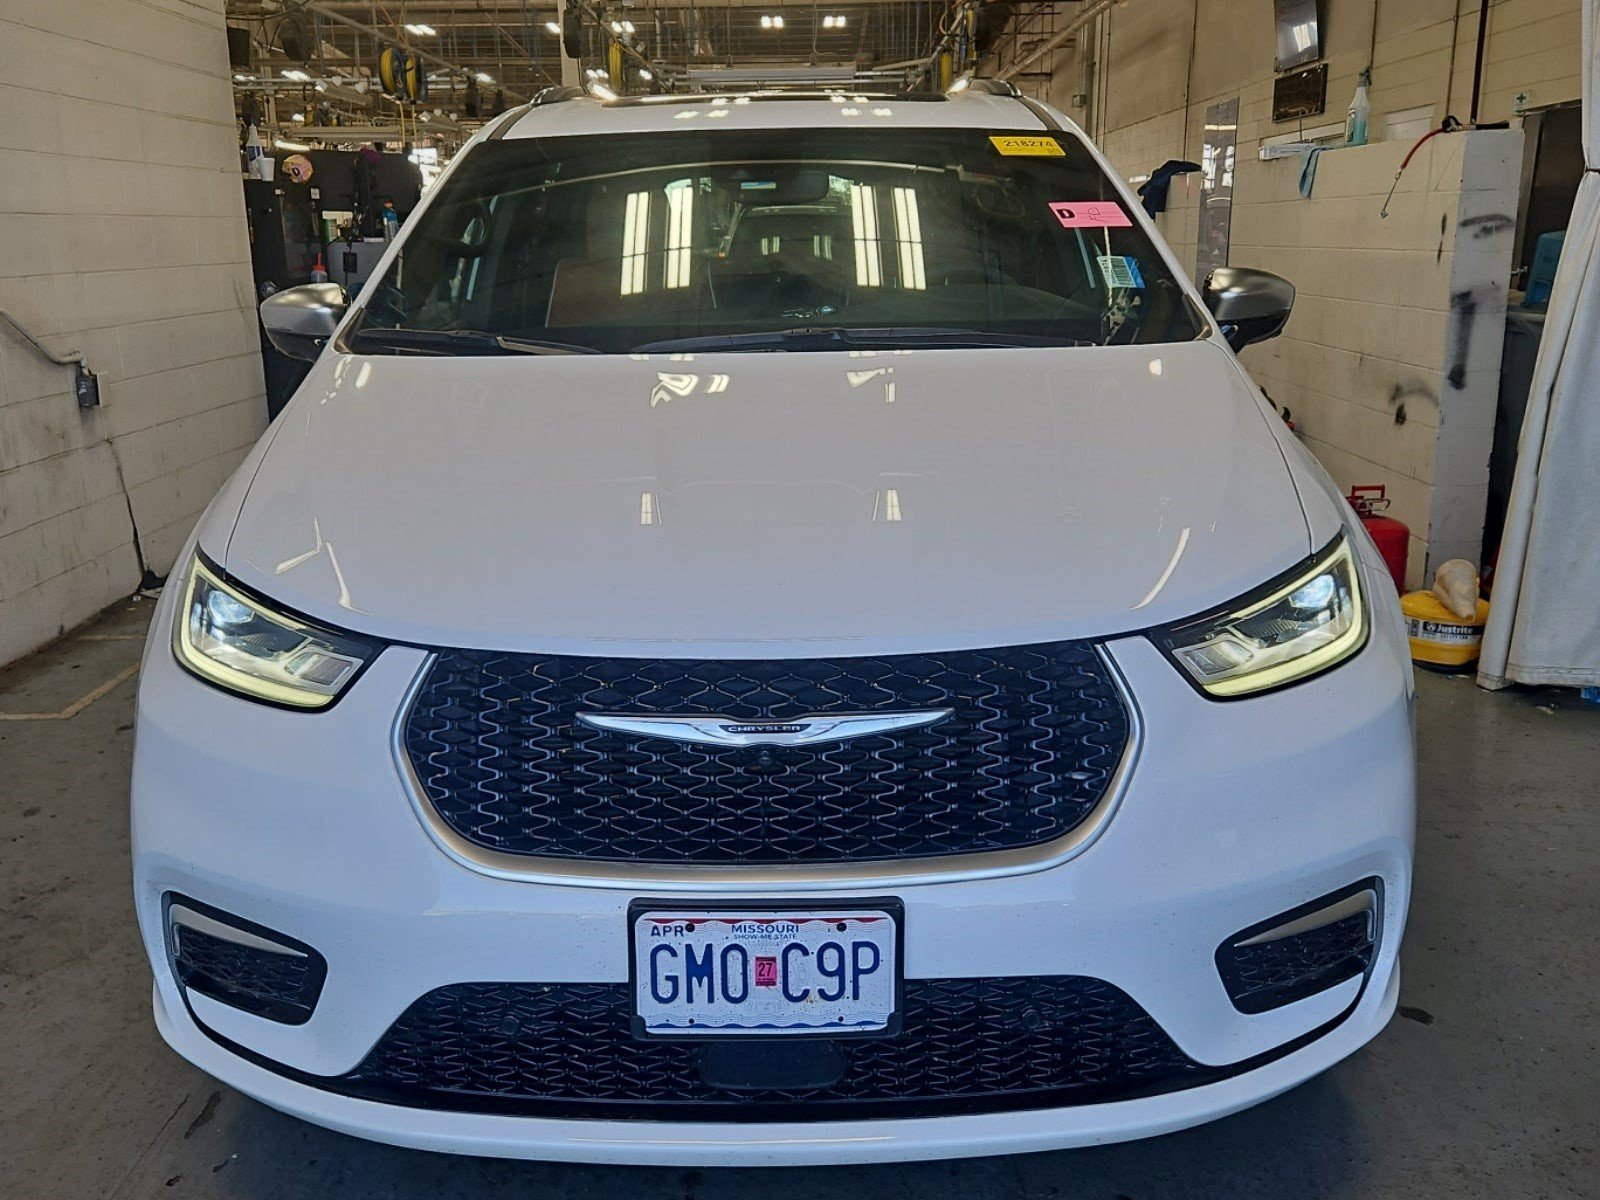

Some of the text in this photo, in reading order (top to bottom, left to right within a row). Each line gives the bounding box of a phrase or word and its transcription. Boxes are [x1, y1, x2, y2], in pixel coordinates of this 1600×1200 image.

[1056, 208, 1075, 219] D
[1437, 624, 1474, 634] Justrite
[651, 925, 684, 937] APR
[731, 924, 799, 934] MISSOURI
[758, 962, 773, 977] 27
[781, 941, 880, 1003] C9P
